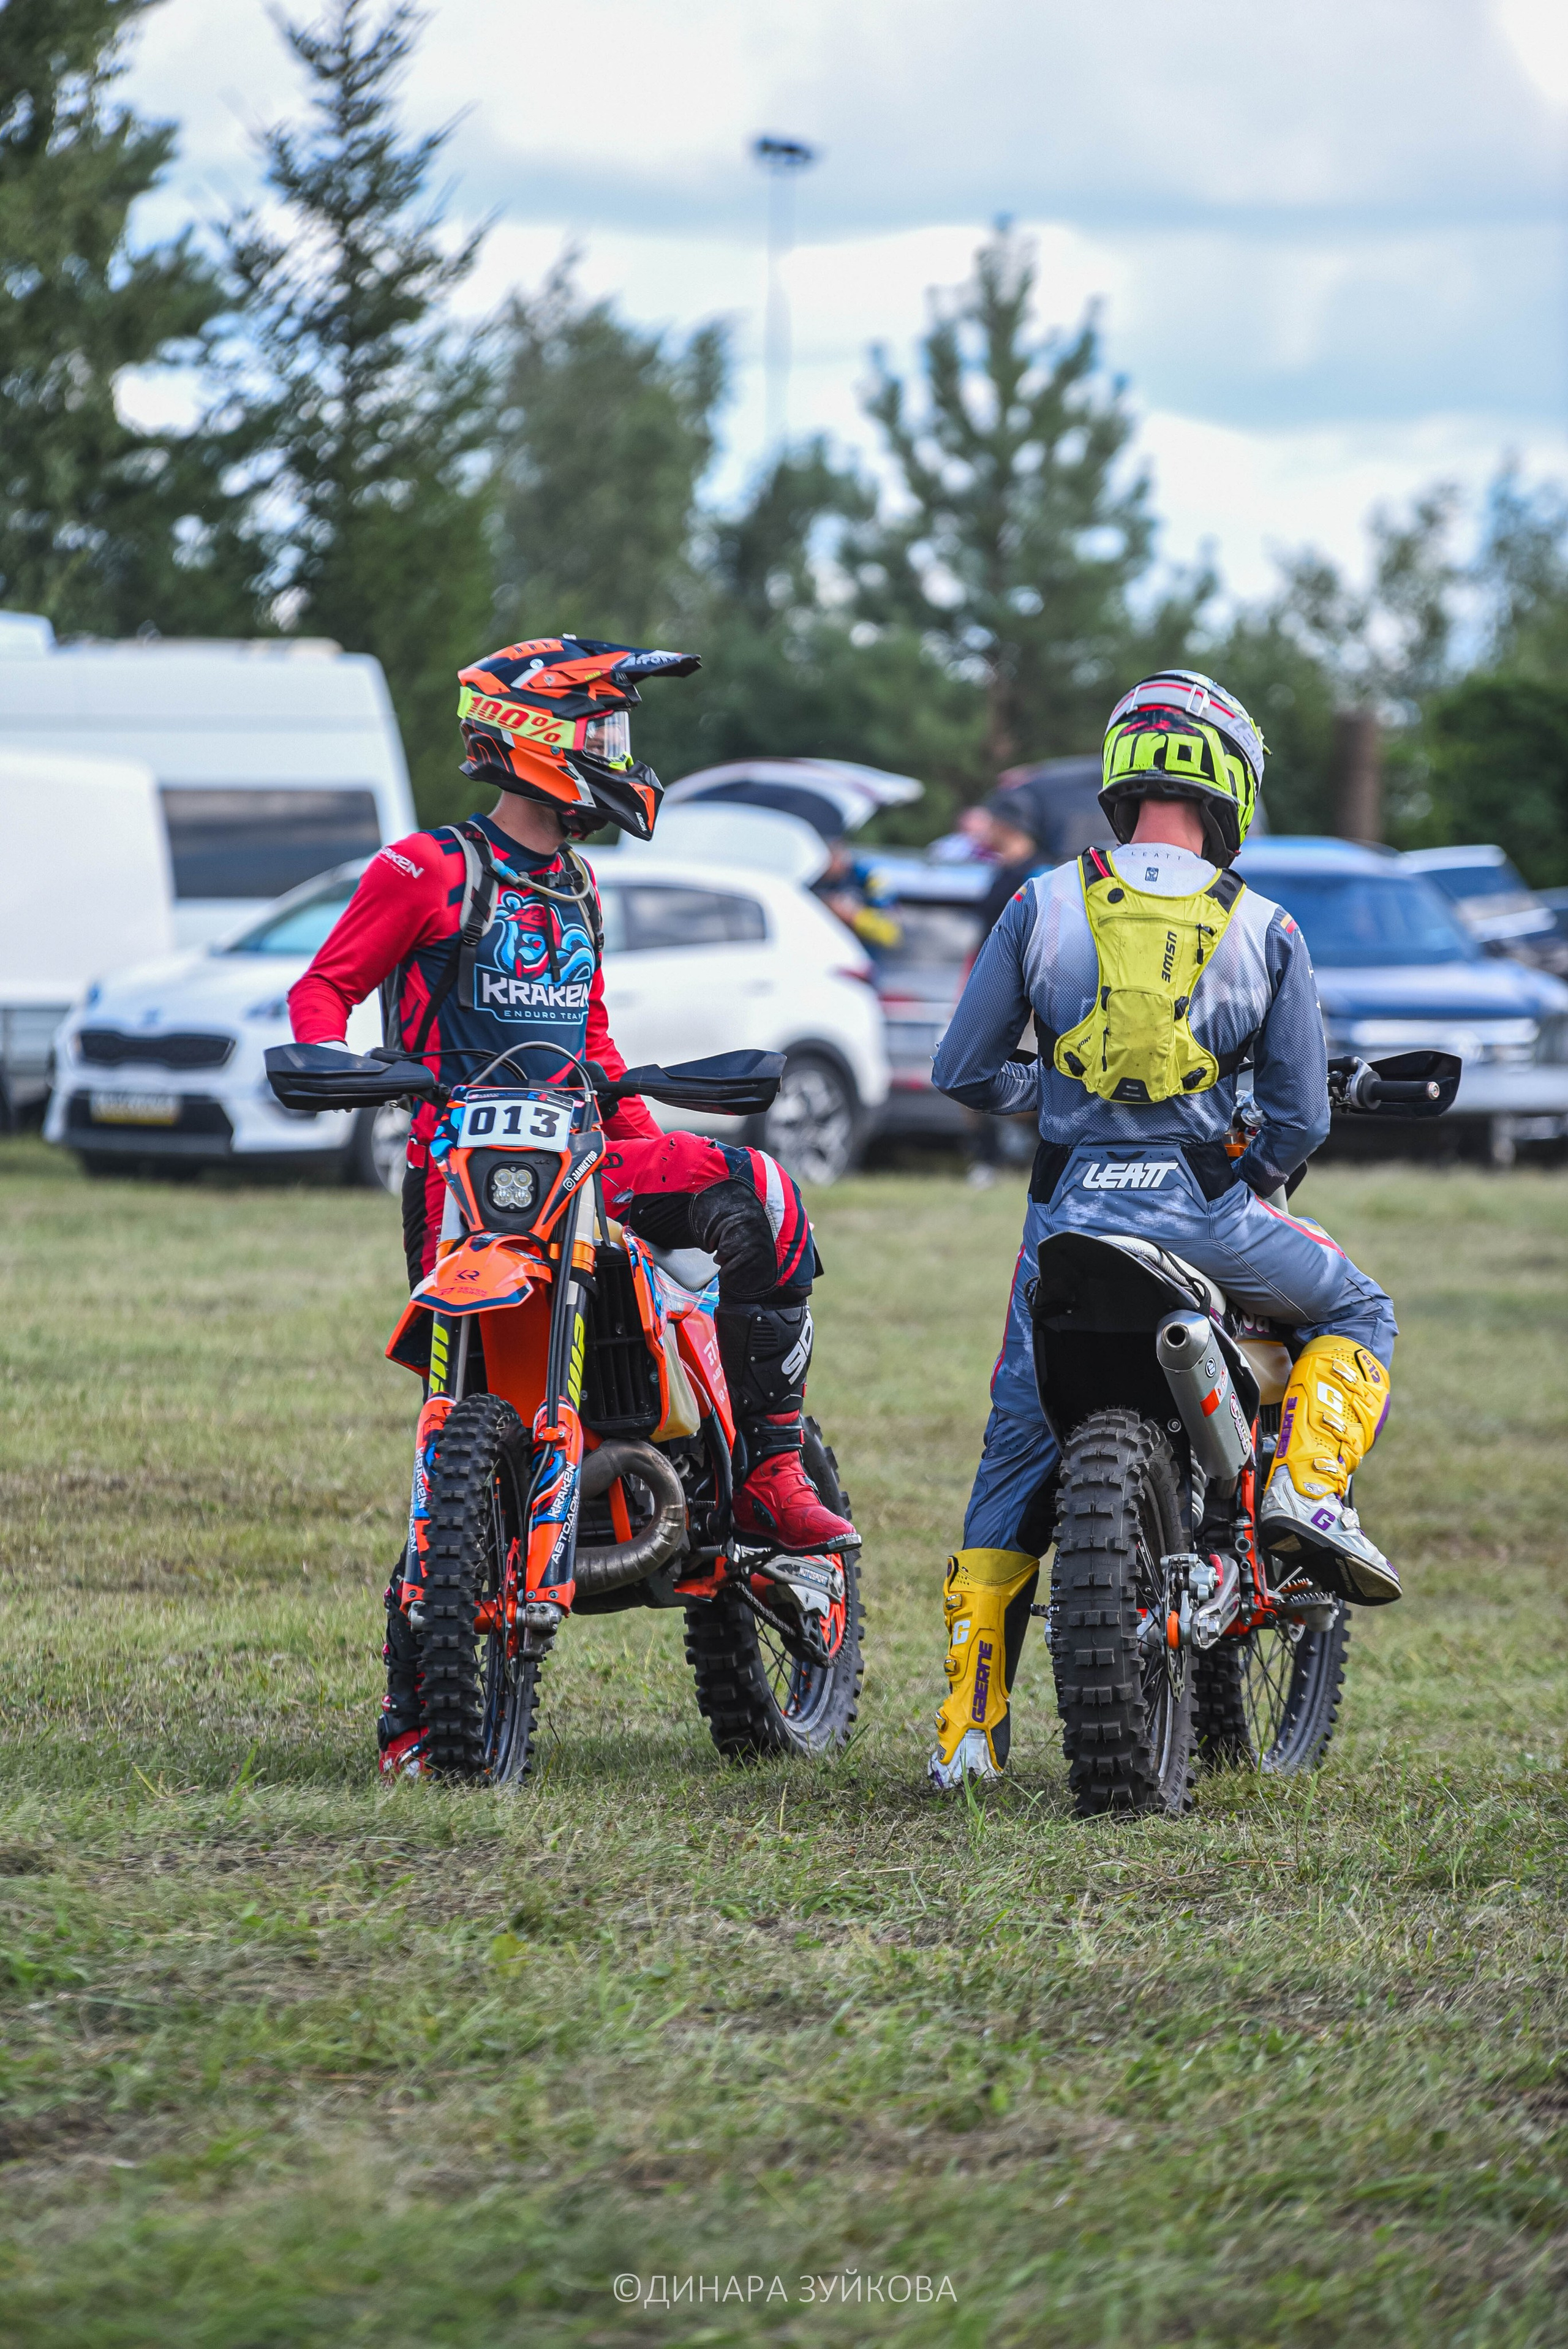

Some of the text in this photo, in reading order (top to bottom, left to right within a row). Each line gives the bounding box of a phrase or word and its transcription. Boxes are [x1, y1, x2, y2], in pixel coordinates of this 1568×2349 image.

[467, 696, 565, 743] 100%
[380, 845, 424, 879] RAKEN
[1131, 851, 1181, 860] LEATT
[1161, 930, 1177, 983] USWE
[504, 1011, 556, 1019] ENDURO
[468, 1106, 560, 1138] 013
[571, 1150, 598, 1182] JANKETOP
[1082, 1163, 1179, 1188] LEATT
[416, 1446, 429, 1509] KRAKEN
[547, 1461, 576, 1518] KRAKEN
[1311, 1507, 1336, 1531] G
